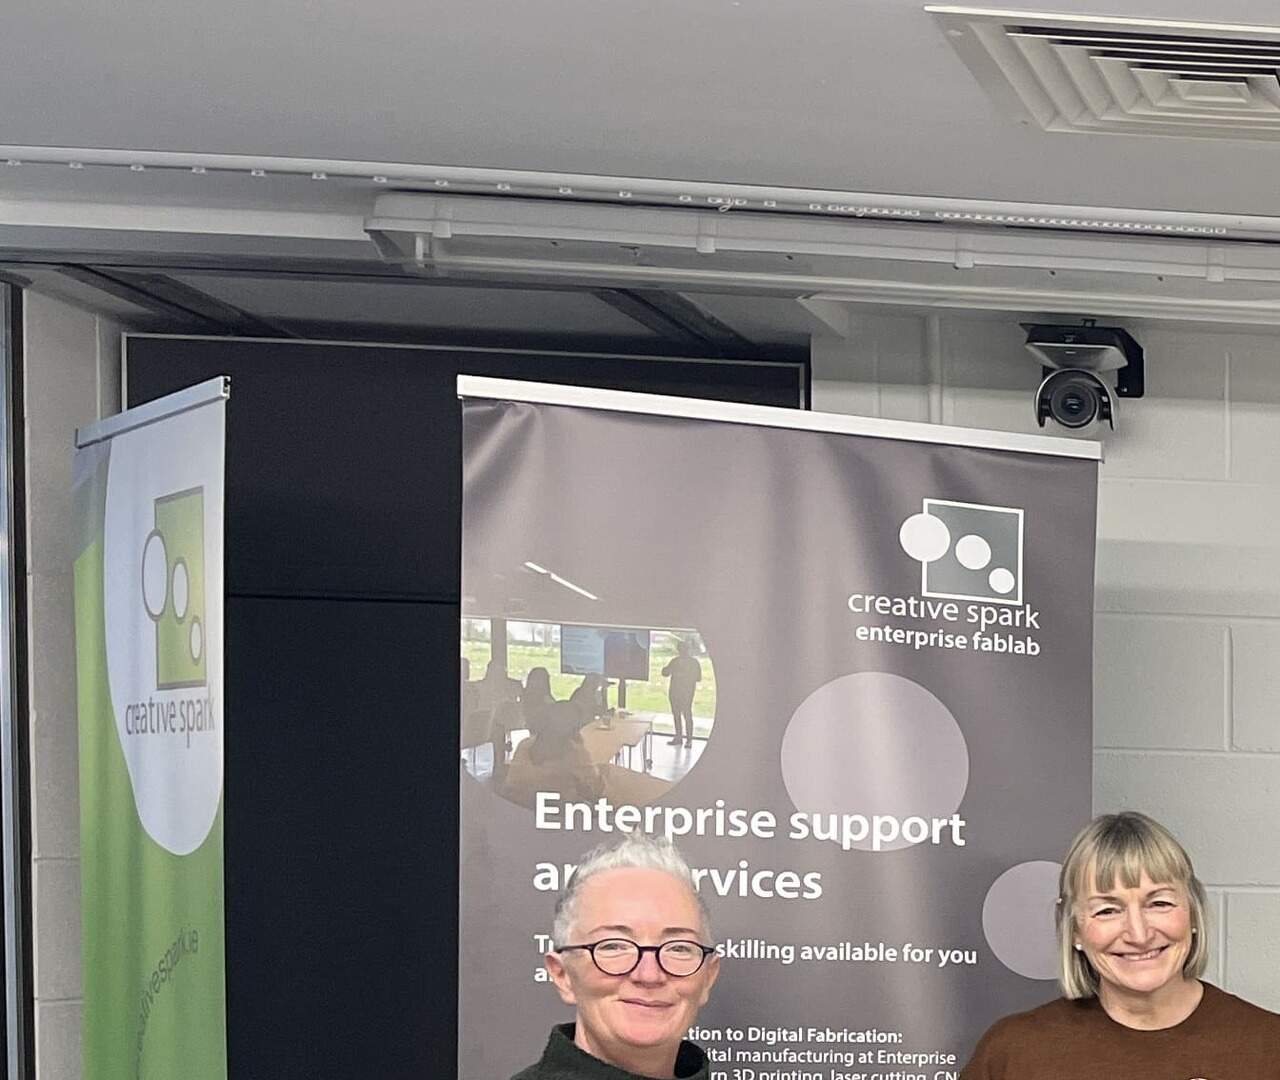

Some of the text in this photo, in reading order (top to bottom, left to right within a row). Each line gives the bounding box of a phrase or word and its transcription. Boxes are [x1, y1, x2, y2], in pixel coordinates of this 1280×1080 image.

[848, 592, 1041, 632] creative spark
[855, 625, 1041, 656] enterprise fablab
[125, 686, 215, 749] creative spark
[534, 791, 967, 851] Enterprise support
[691, 860, 823, 899] rvices
[715, 939, 977, 968] skilling available for you
[726, 1028, 744, 1042] to
[748, 1027, 803, 1045] Digital
[807, 1028, 903, 1044] Fabrication:
[706, 1048, 957, 1068] ital manufacturing at Enterprise
